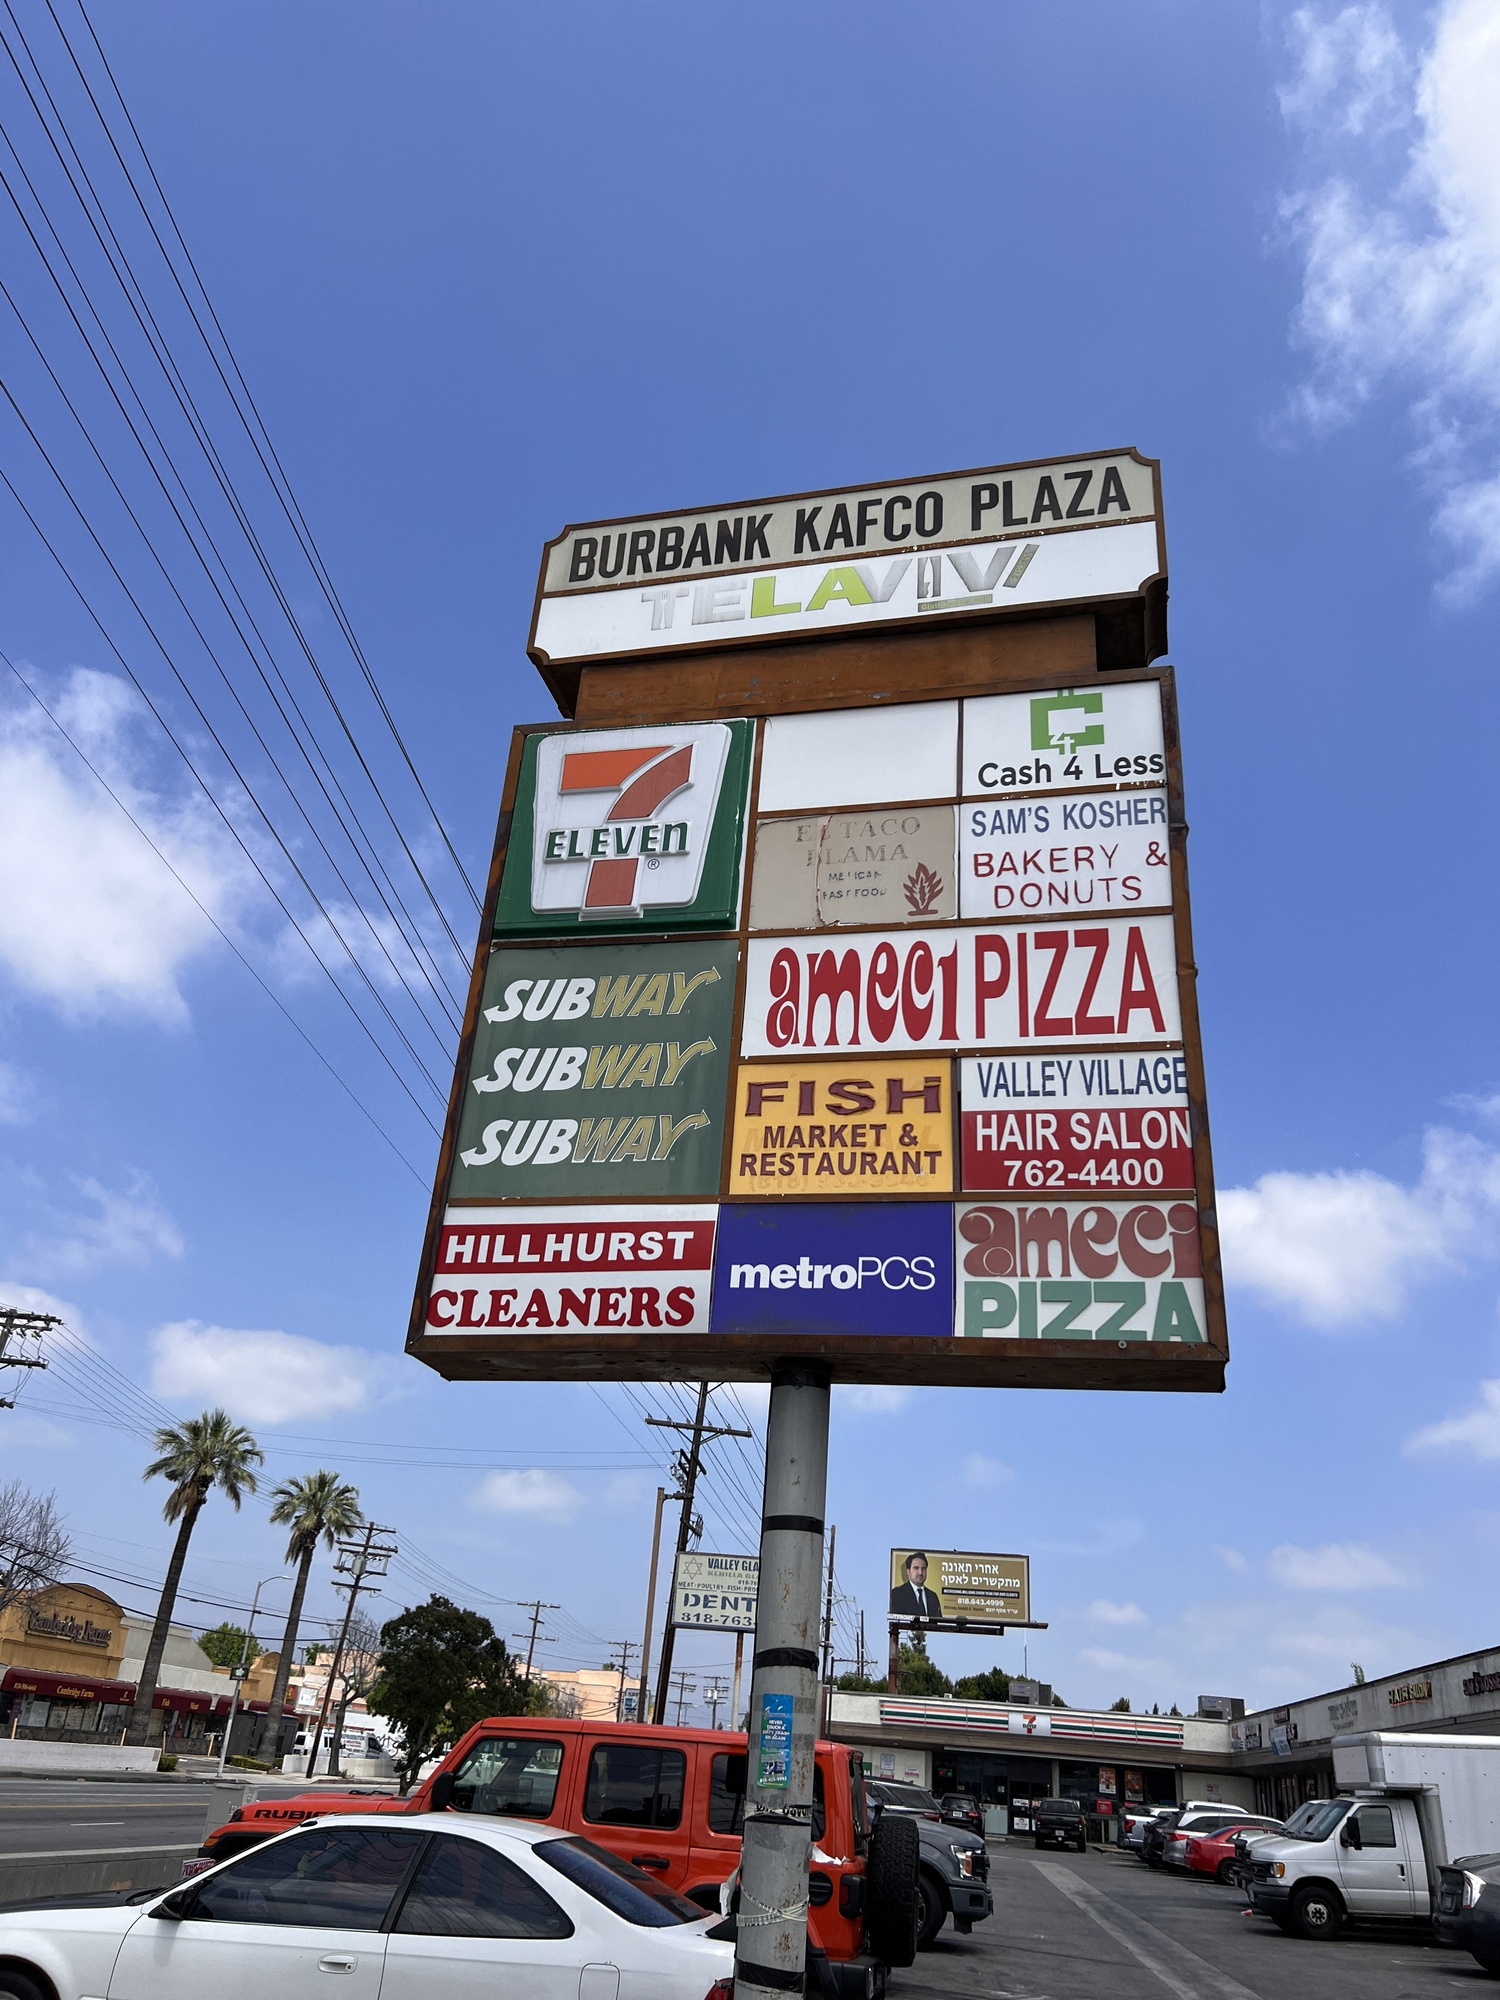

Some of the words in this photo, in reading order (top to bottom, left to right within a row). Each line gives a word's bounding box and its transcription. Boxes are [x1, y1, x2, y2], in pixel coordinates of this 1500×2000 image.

[568, 513, 772, 583] BURBANK
[793, 491, 943, 555] KAFCO
[971, 466, 1131, 532] PLAZA
[978, 758, 1052, 788] Cash
[1063, 755, 1083, 781] 4
[1095, 753, 1164, 779] Less
[561, 742, 694, 908] 7
[839, 816, 921, 838] TACO
[971, 805, 1050, 837] SAM'S
[1063, 797, 1167, 831] KOSHER
[828, 870, 882, 881] MEICAN
[973, 843, 1119, 878] BAKERY
[1145, 841, 1169, 867] &
[994, 875, 1142, 909] DONUTS
[483, 966, 721, 1024] SUBWAY
[975, 926, 1166, 1039] PIZZA
[472, 1036, 717, 1095] SUBWAY
[977, 1060, 1074, 1098] VALLEY
[1079, 1056, 1187, 1097] VILLAGE
[744, 1076, 942, 1117] FISH
[459, 1109, 711, 1168] SUBWAY
[763, 1123, 887, 1149] MARKET
[898, 1123, 918, 1147] &
[976, 1112, 1057, 1151] HAIR
[1070, 1110, 1192, 1150] SALON
[739, 1151, 943, 1177] RESTAURANT
[1004, 1158, 1164, 1188] 762-4400
[445, 1231, 694, 1263] HILLHURST
[729, 1256, 936, 1291] metroPCS
[426, 1286, 695, 1328] CLEANERS
[964, 1281, 1203, 1342] PIZZA
[708, 1557, 740, 1571] VALLEY
[941, 1561, 973, 1573] תאונה
[941, 1573, 969, 1586] לאסף
[975, 1563, 999, 1575] אחרי
[971, 1576, 1021, 1589] מתקשרים
[683, 1592, 757, 1613] DENT
[957, 1597, 1004, 1607] 818.643.4999
